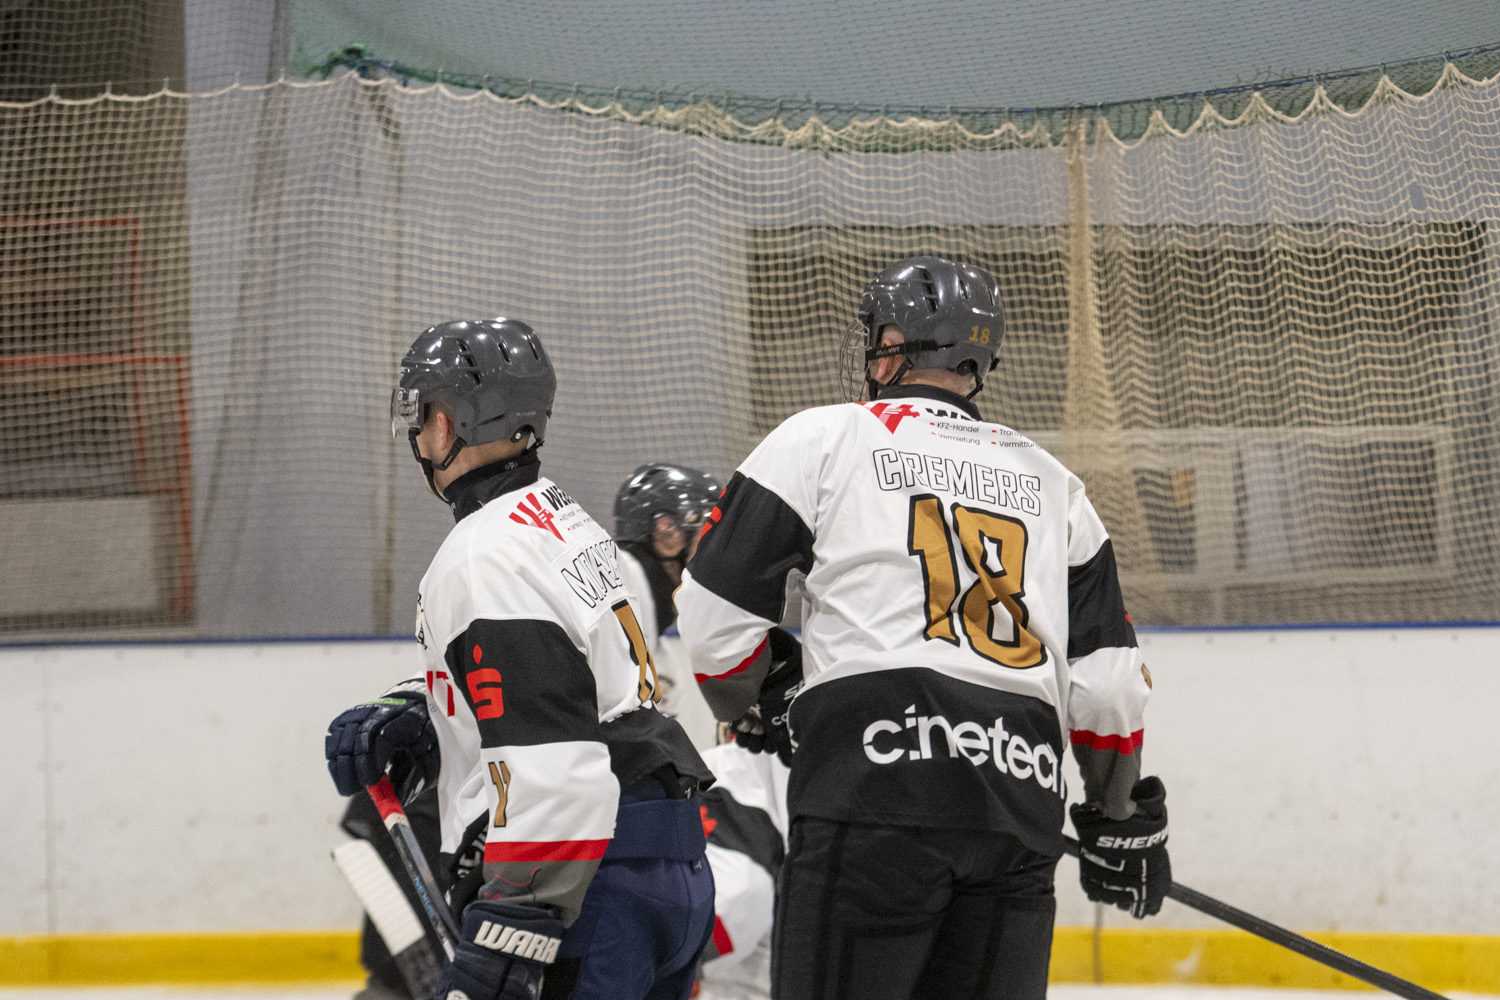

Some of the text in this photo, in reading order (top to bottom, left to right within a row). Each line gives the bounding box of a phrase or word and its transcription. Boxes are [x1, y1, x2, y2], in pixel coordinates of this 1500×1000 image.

[969, 326, 990, 344] 18
[937, 422, 980, 434] KFZ-Handel
[999, 441, 1042, 450] Vermittlu
[873, 448, 1041, 516] CREMERS
[907, 493, 1048, 670] 18
